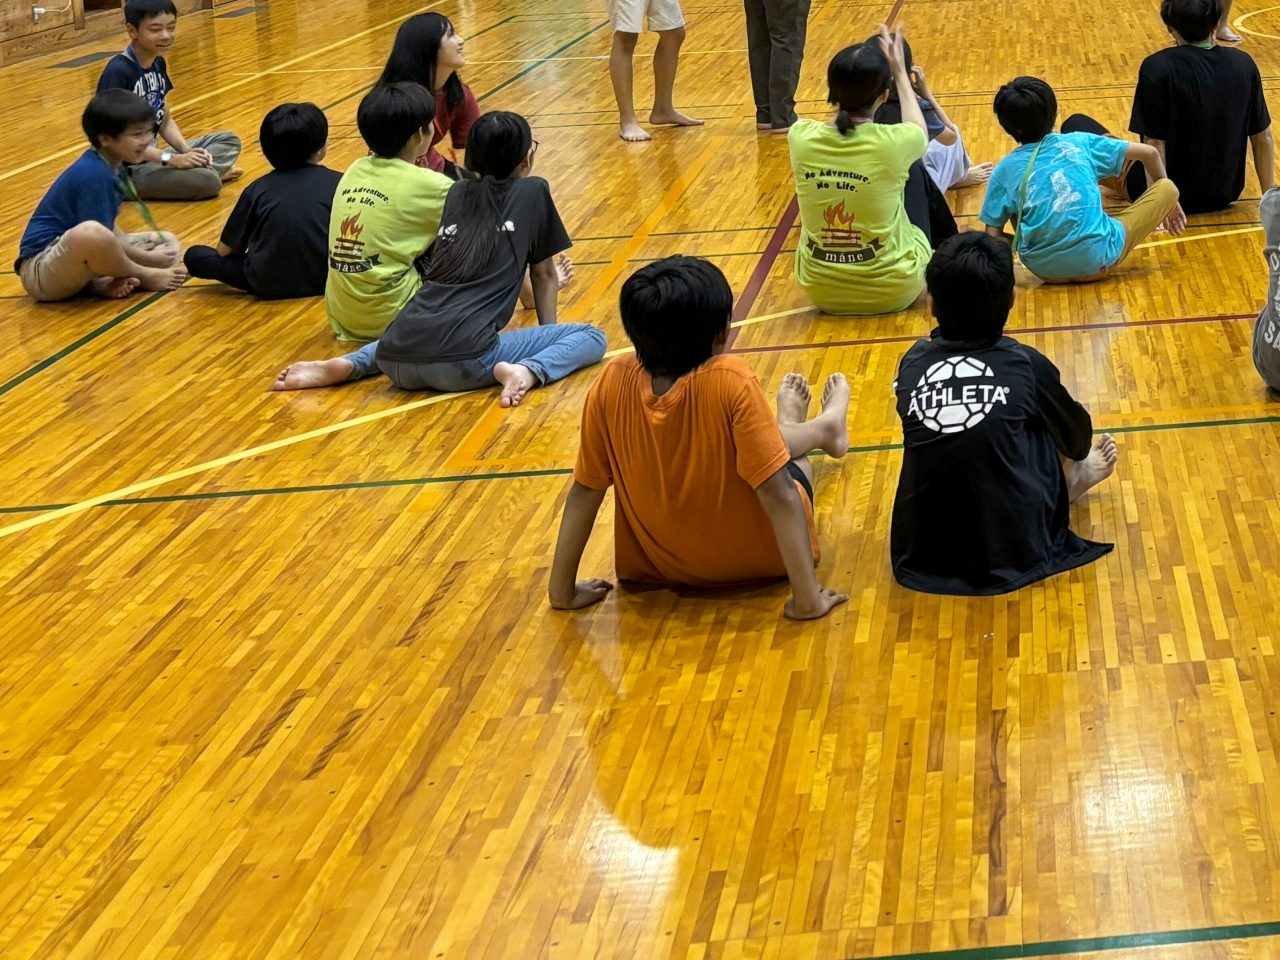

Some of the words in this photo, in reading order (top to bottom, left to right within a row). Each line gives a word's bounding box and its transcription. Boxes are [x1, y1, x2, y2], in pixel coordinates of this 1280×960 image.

[804, 171, 816, 180] No
[819, 169, 871, 185] Adventure.
[816, 181, 830, 190] No
[836, 181, 858, 193] Life.
[907, 384, 1008, 416] ATHLETA
